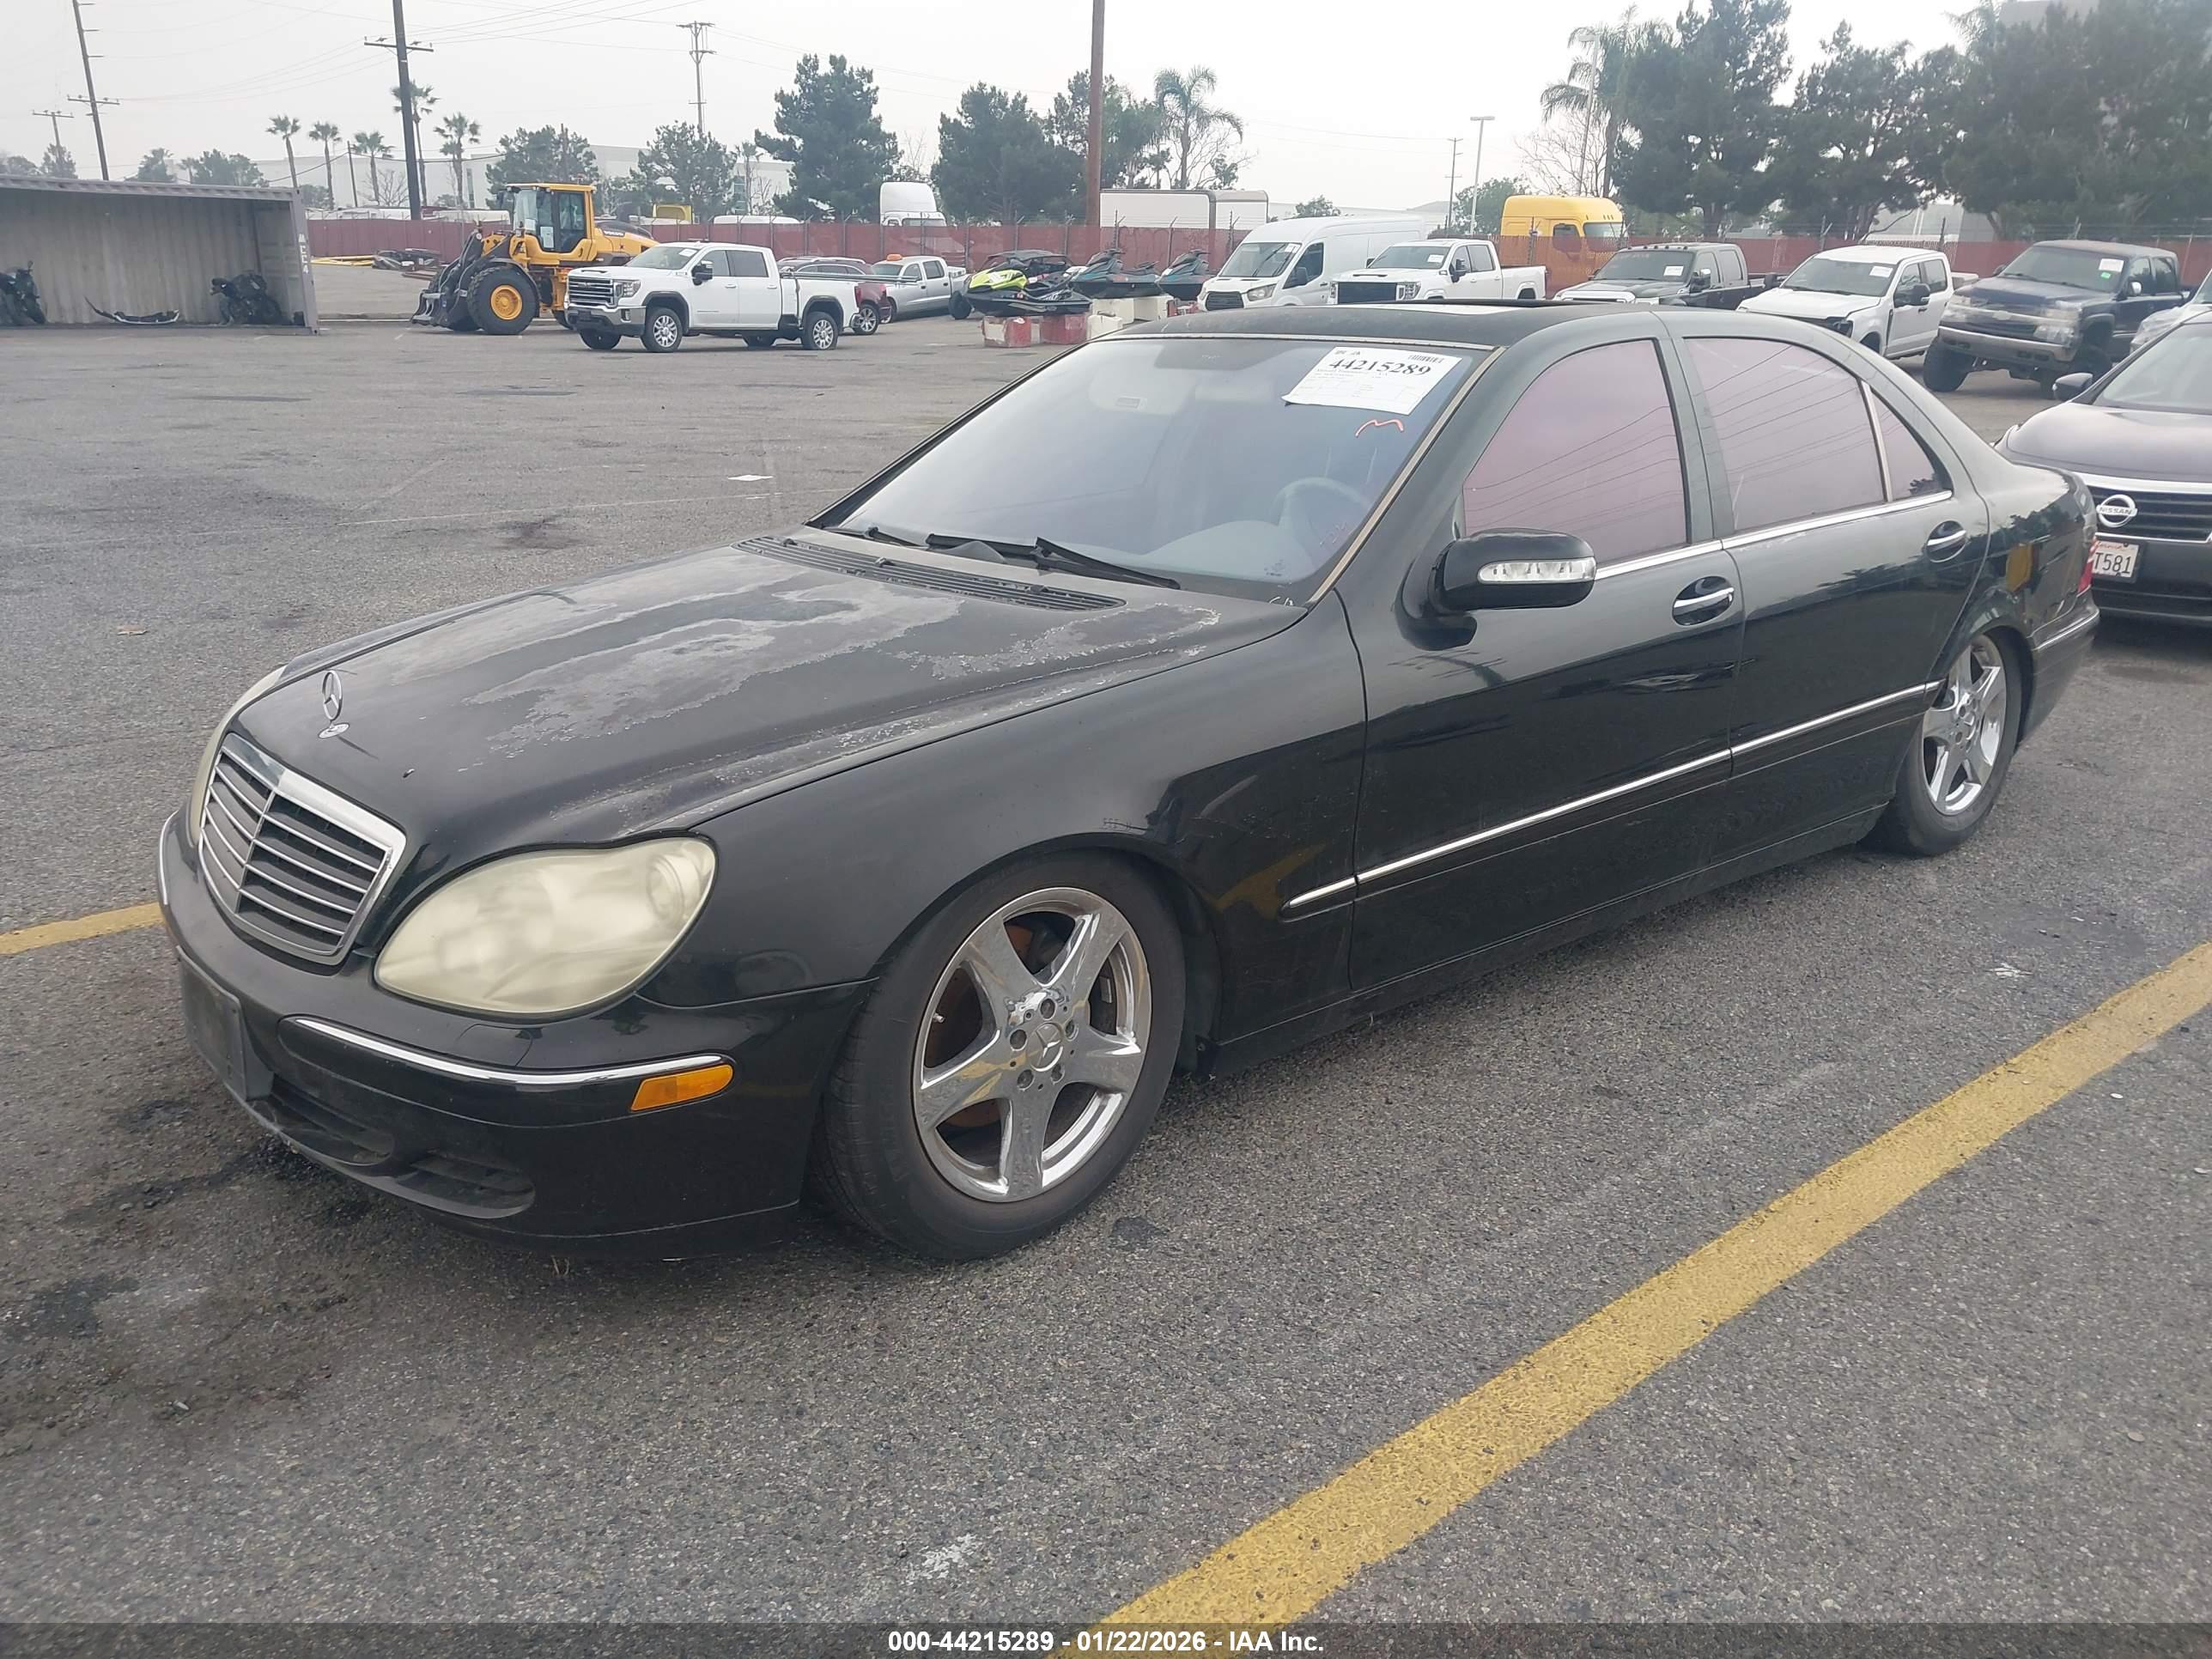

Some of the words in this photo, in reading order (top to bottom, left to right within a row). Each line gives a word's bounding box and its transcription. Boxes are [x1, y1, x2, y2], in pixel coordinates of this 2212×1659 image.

[1329, 359, 1431, 375] 44215289
[2099, 506, 2133, 515] NISSAN
[2094, 552, 2131, 574] T581
